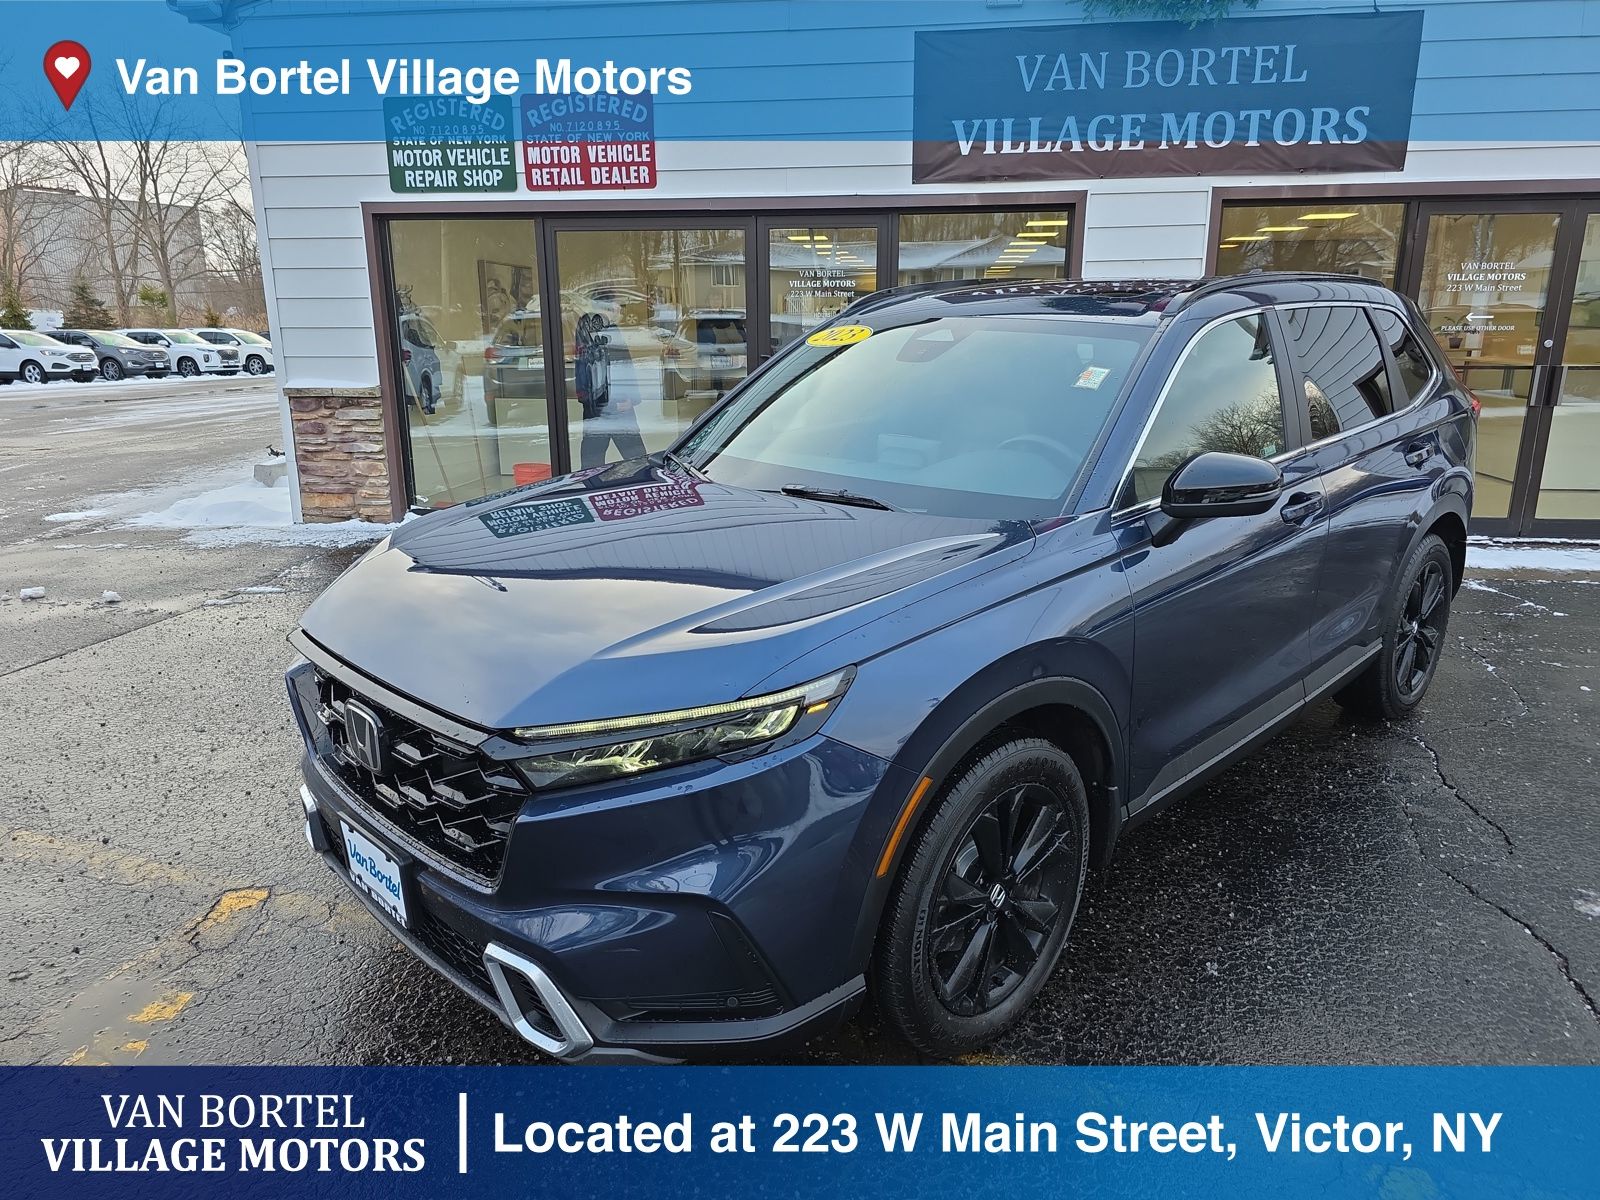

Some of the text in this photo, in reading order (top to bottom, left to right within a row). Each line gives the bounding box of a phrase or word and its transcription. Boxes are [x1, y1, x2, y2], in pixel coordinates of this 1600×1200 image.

[1016, 44, 1307, 92] VAN BORTEL
[390, 98, 505, 134] REGISTERED
[526, 94, 648, 128] REGISTERED
[430, 125, 485, 135] 7120895
[567, 121, 620, 131] 7120895
[952, 106, 1370, 156] VILLAGE MOTORS
[393, 134, 507, 146] STATE OF NEW YORK
[526, 132, 650, 143] STATE OF NEW YORK
[392, 148, 510, 167] MOTOR VEHICLE
[527, 144, 651, 164] MOTOR VEHICLE
[404, 169, 503, 188] REPAIR SHOP
[531, 166, 650, 186] RETAIL DEALER
[1460, 262, 1516, 270] VAN BORTEL
[799, 270, 846, 278] VAN BORTEL
[1486, 272, 1526, 280] MOTORS
[789, 280, 856, 288] VILLAGE MOTORS
[1474, 284, 1496, 292] Main
[1497, 284, 1522, 292] Street
[790, 290, 804, 298] 223
[814, 290, 832, 298] Main
[833, 290, 855, 298] Street
